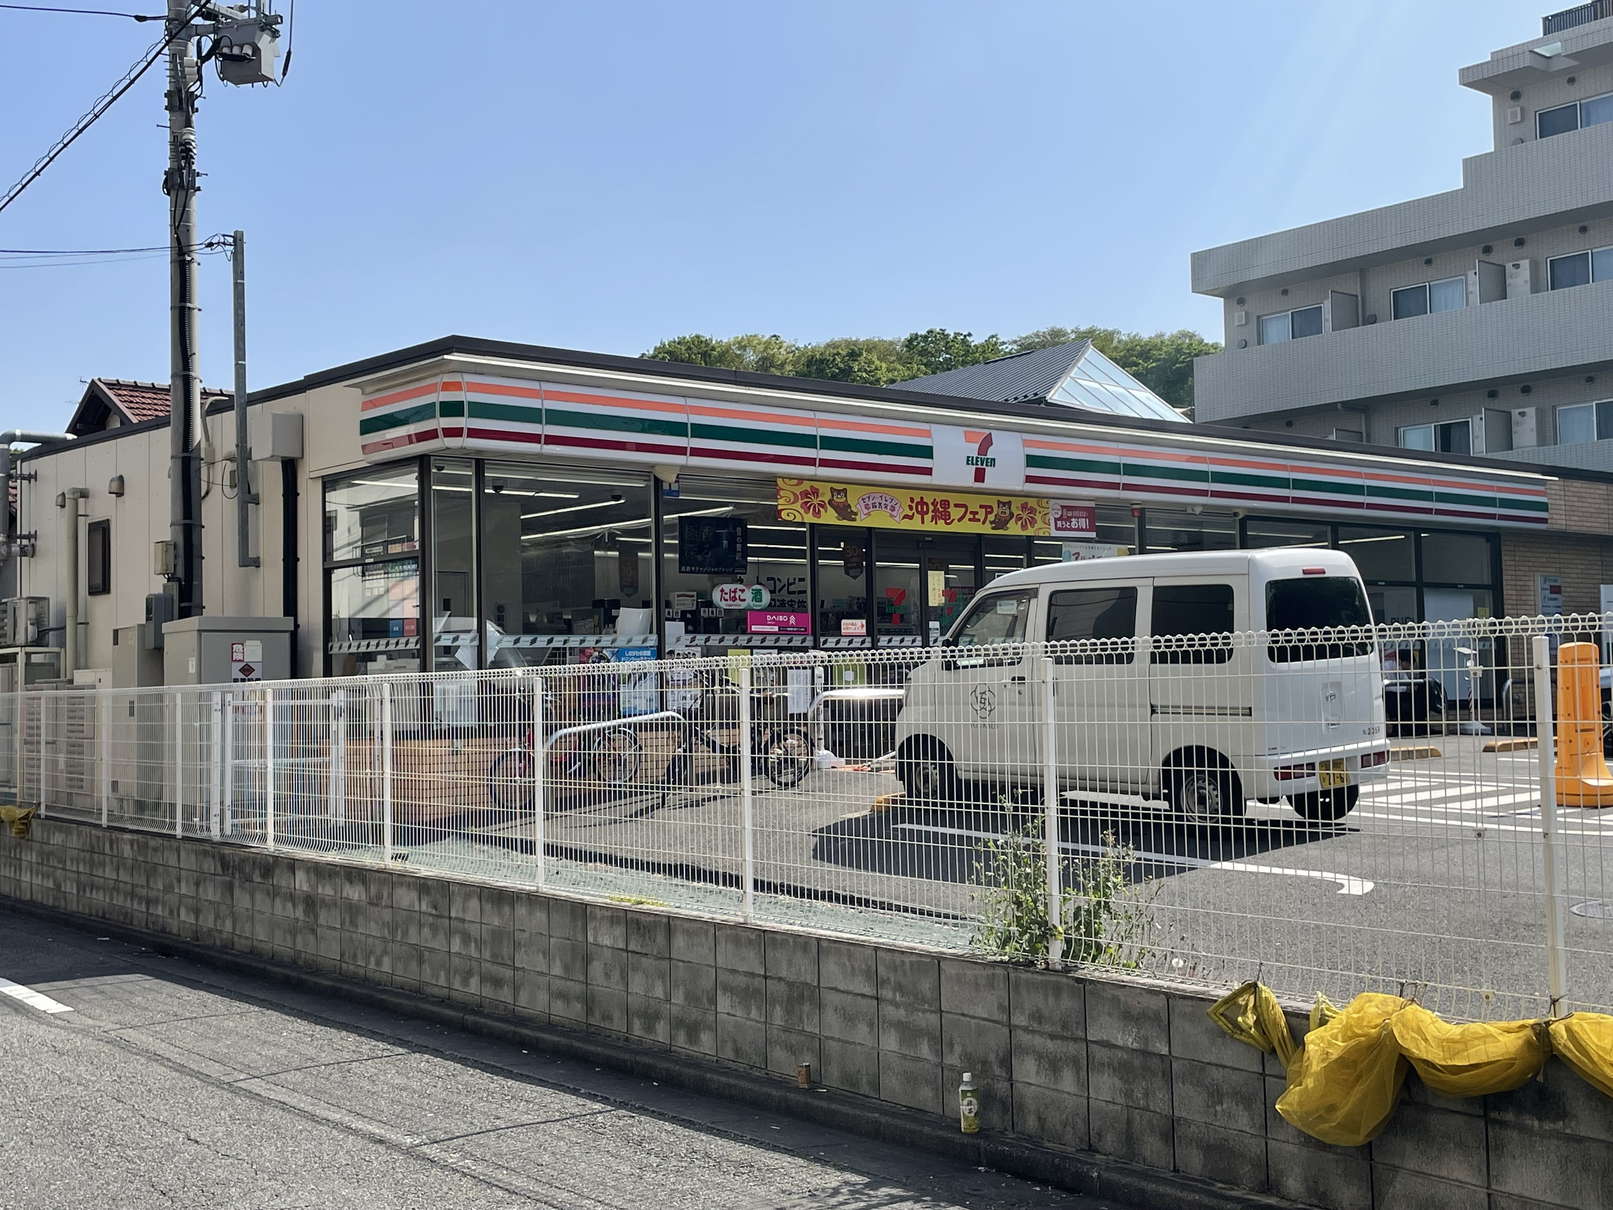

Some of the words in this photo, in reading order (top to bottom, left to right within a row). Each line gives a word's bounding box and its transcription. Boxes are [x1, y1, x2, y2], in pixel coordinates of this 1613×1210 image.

[901, 496, 994, 525] 沖縄フェア
[719, 587, 746, 602] たばこ
[751, 588, 763, 602] 酒
